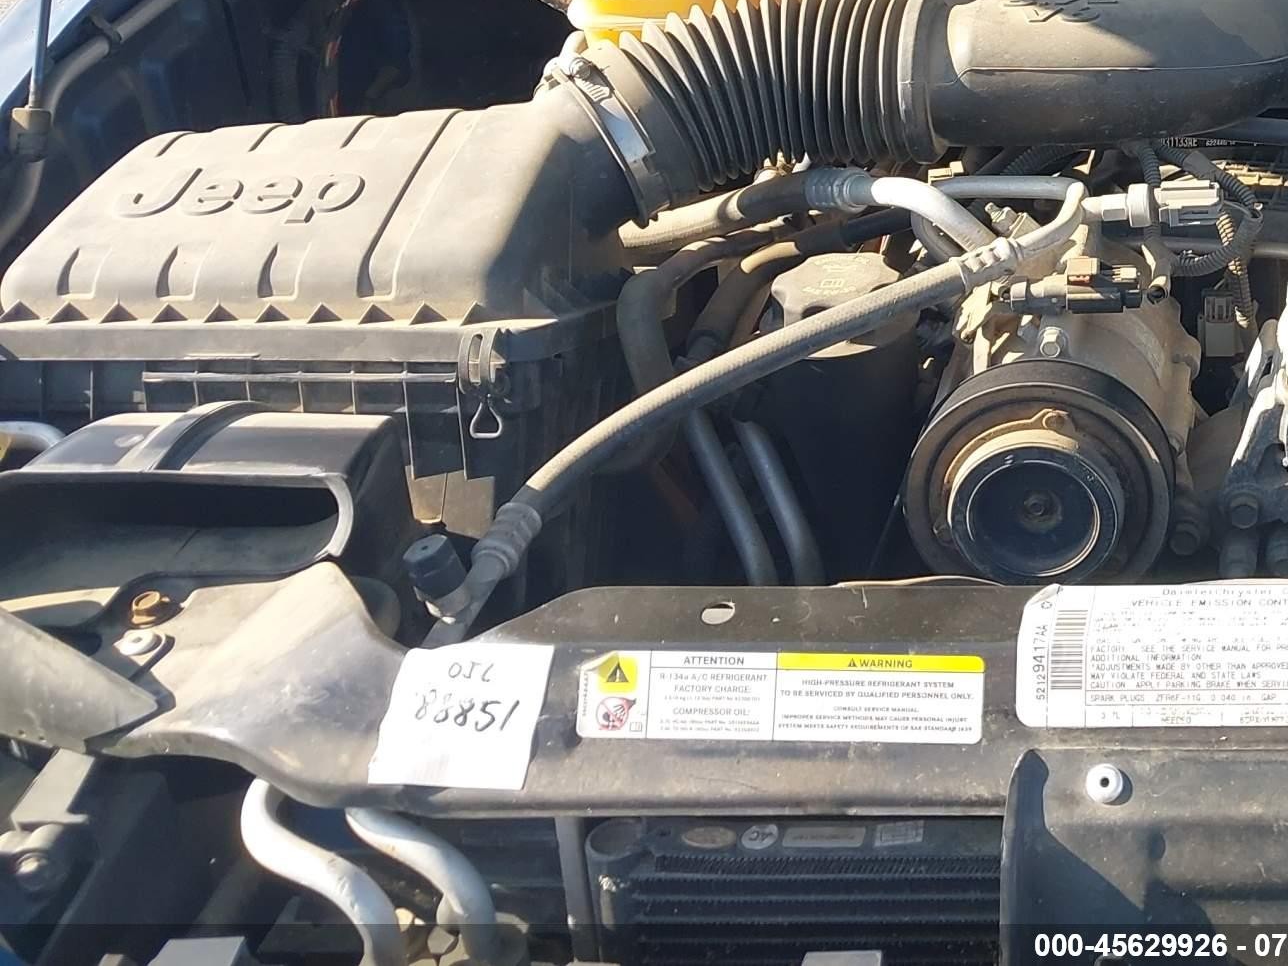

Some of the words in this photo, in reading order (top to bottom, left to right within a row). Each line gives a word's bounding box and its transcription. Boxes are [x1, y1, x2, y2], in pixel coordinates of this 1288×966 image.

[113, 167, 366, 224] Jeep
[1131, 598, 1182, 607] VEHICLE
[1191, 598, 1252, 607] EMISSION
[683, 656, 745, 666] ATTENTION
[859, 659, 913, 669] WARNING
[691, 673, 708, 681] A/C
[710, 673, 768, 682] REFRIGERANT
[1211, 671, 1238, 679] STATE
[801, 679, 865, 687] HIGH-PRESSURE
[867, 680, 921, 688] REFRIGERANT
[923, 681, 954, 689] SYSTEM
[1135, 681, 1161, 689] APPLY
[674, 685, 712, 693] FACTORY
[714, 685, 751, 694] CHARGE:
[780, 689, 791, 697] TO
[804, 690, 843, 698] SERVICED
[857, 691, 900, 699] QUALIFIED
[901, 692, 949, 700] PERSONNEL
[1090, 694, 1115, 702] SPARK
[672, 707, 730, 716] COMPRESSOR
